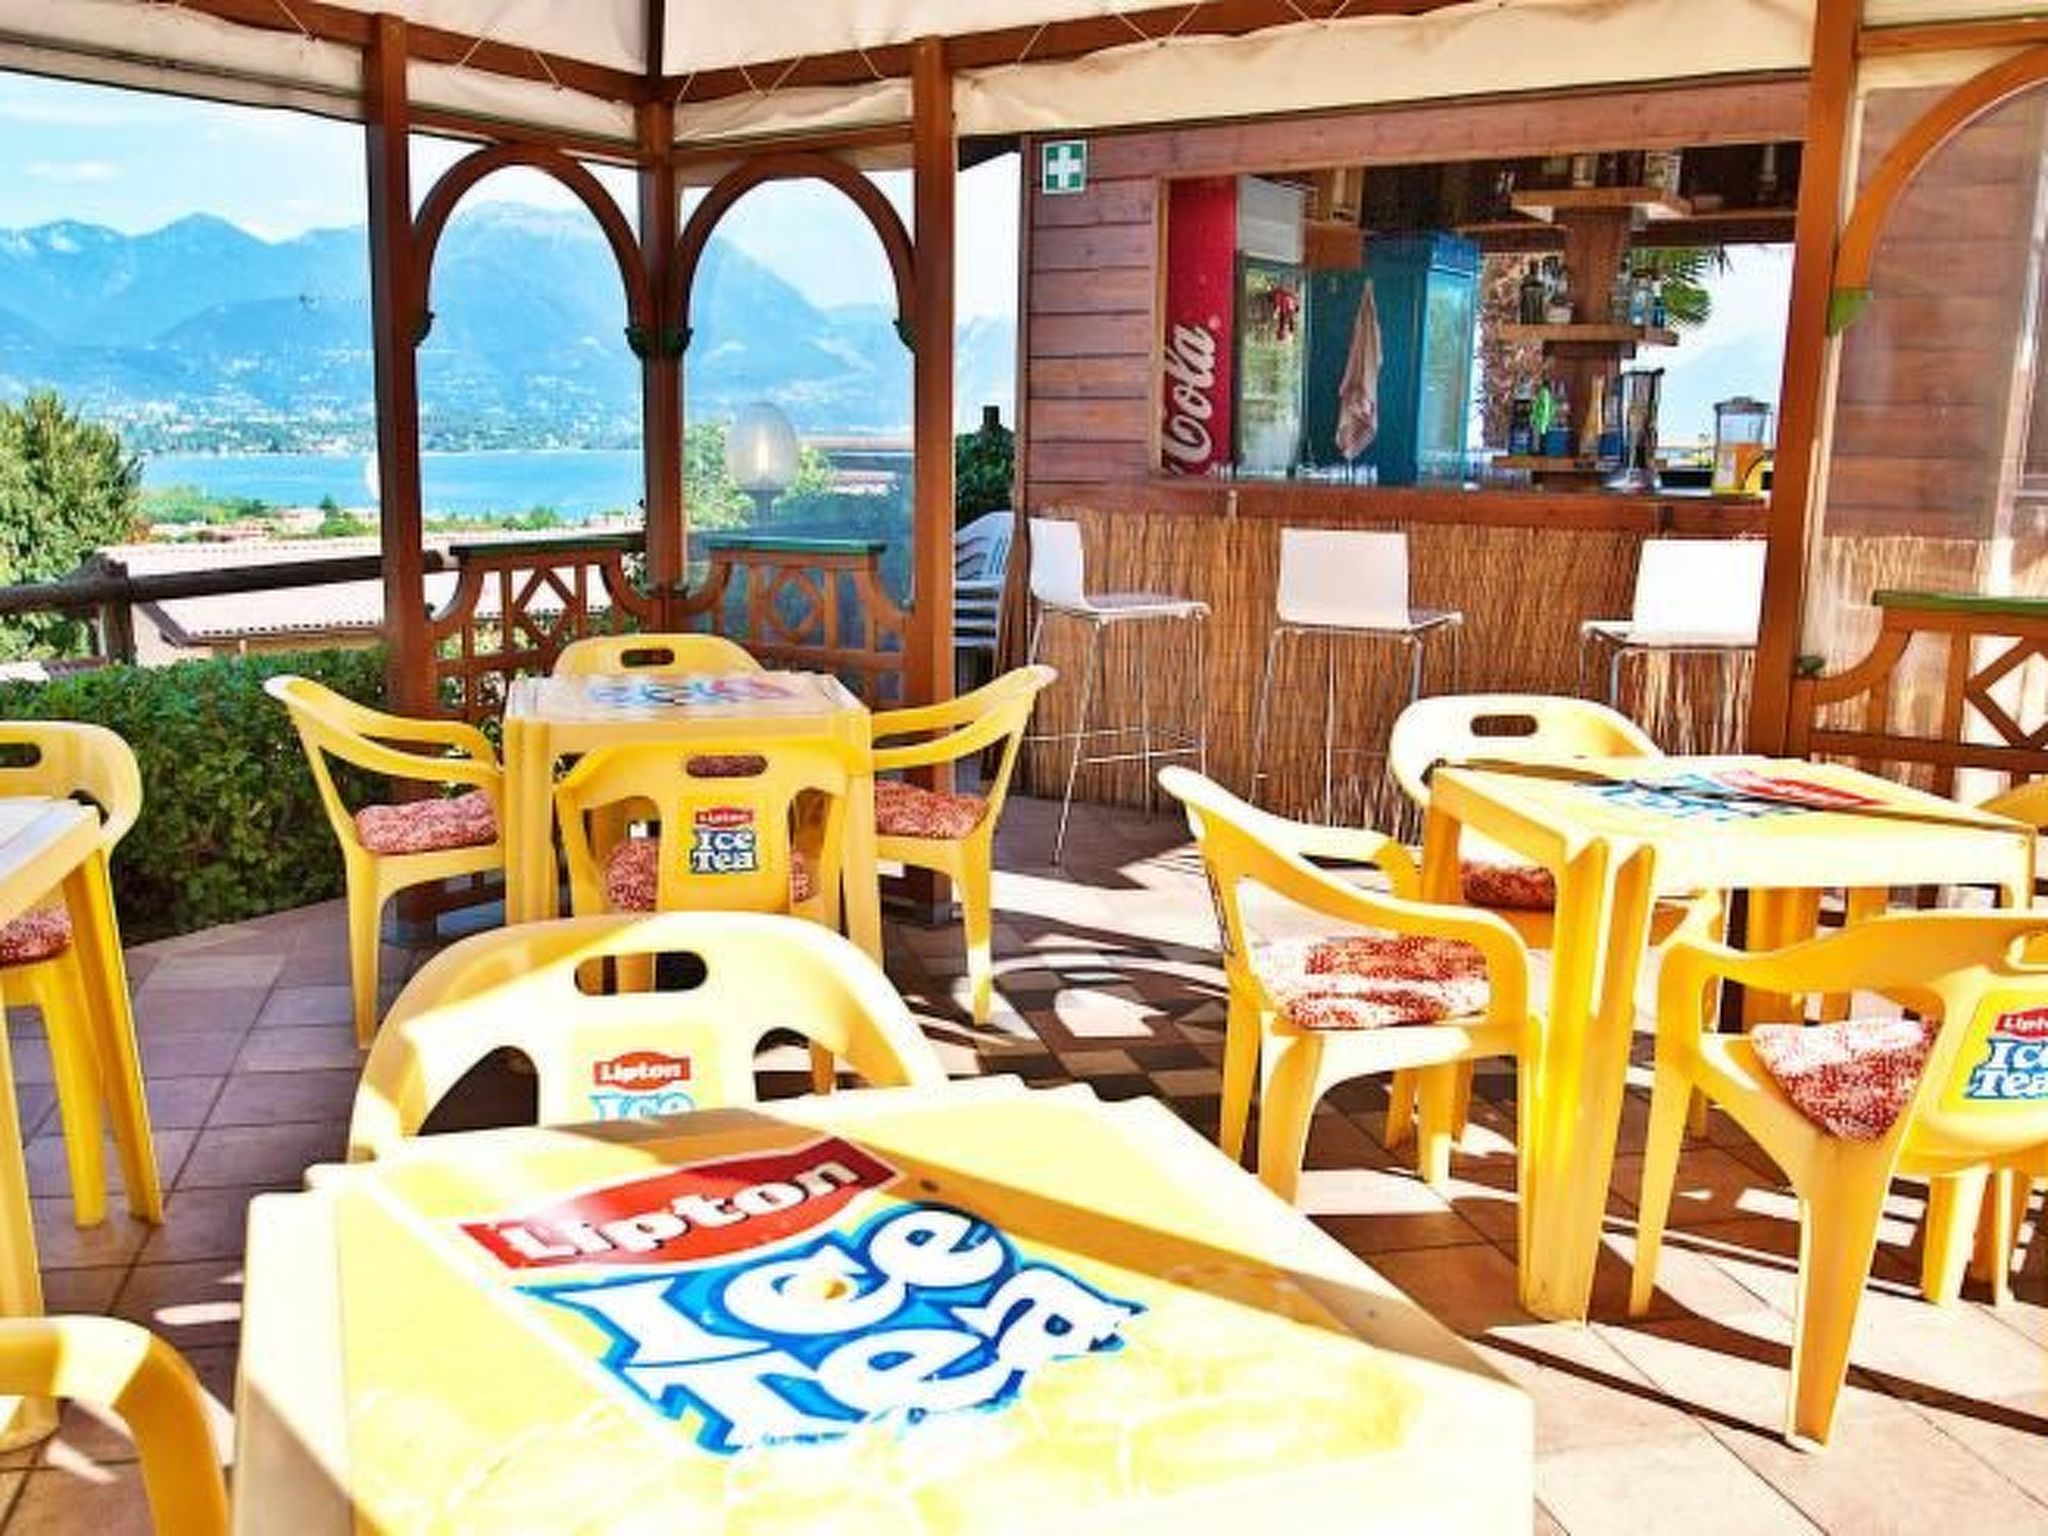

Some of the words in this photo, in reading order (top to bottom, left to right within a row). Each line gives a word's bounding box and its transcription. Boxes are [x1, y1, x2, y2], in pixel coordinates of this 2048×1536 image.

[691, 849, 757, 872] Tea
[2004, 1014, 2048, 1034] Lipt
[601, 1060, 682, 1083] Lipton
[502, 1156, 859, 1260] Lipton
[545, 1202, 1010, 1368] Ice
[620, 1262, 1146, 1452] Tea
